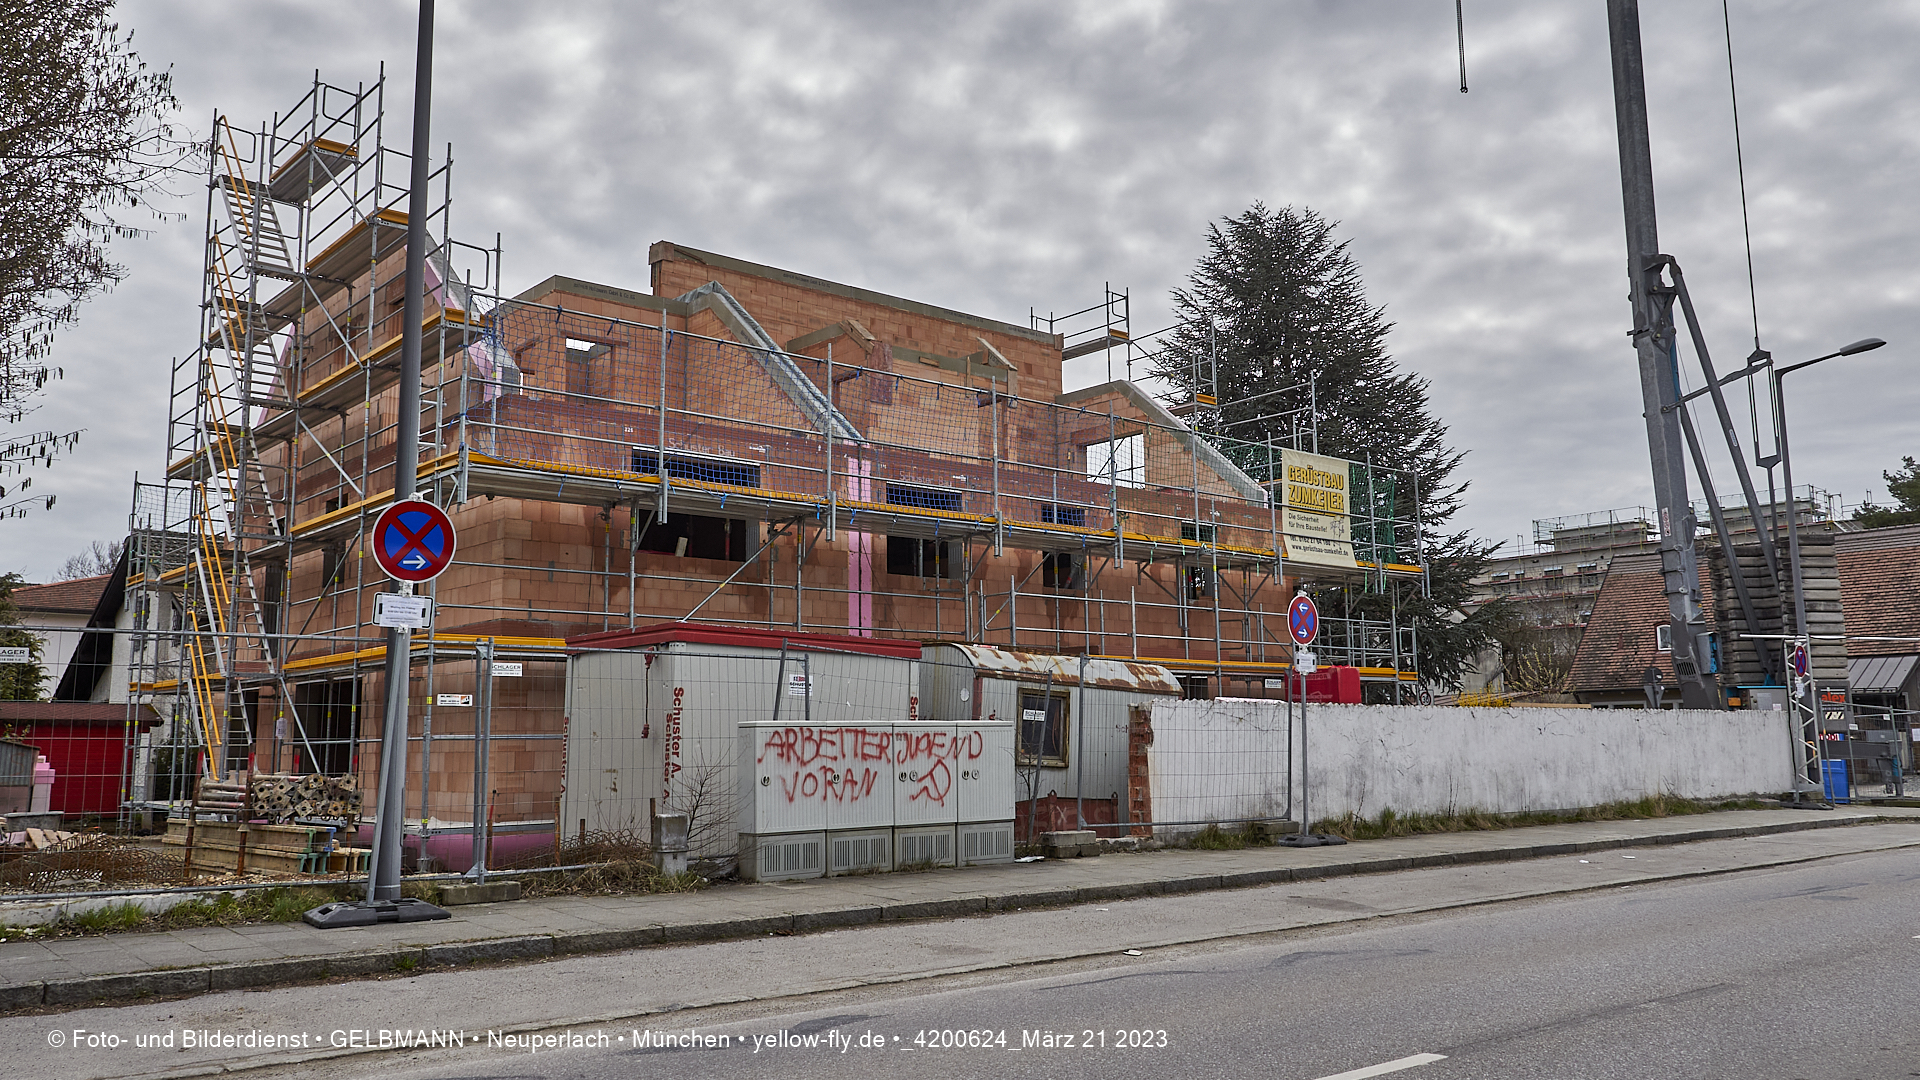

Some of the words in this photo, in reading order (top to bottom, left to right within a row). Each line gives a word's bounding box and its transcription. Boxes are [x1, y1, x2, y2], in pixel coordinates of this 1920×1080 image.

[1288, 465, 1344, 490] GERÜSTBAU
[1288, 484, 1344, 510] ZUMKELLER
[1297, 513, 1319, 522] Sicherheit
[1821, 692, 1845, 703] alex
[671, 686, 684, 758] Schuster
[560, 716, 570, 781] Schuster
[664, 712, 673, 785] Schuster
[670, 761, 682, 779] A.
[779, 765, 878, 803] VORAN
